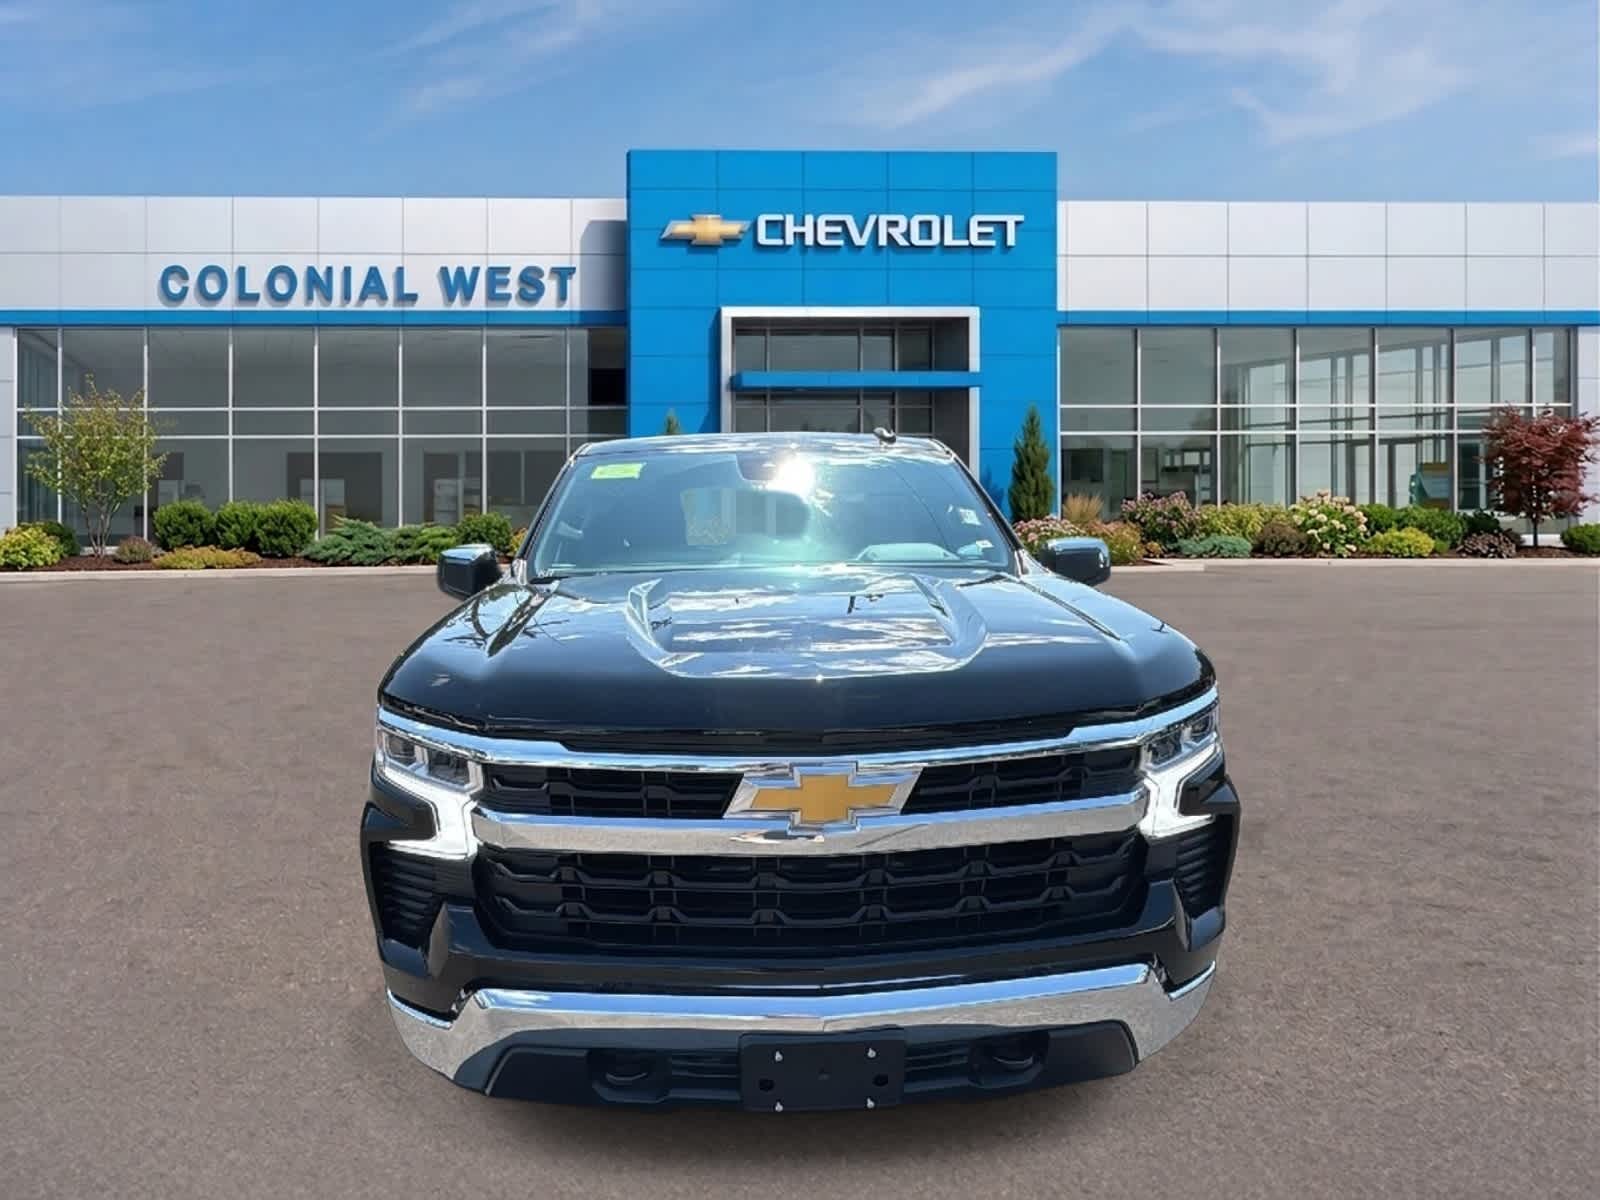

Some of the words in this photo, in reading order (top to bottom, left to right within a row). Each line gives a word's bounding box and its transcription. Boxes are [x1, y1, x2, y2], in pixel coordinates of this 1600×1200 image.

[756, 213, 1025, 247] CHEVROLET
[160, 264, 418, 303] COLONIAL
[439, 265, 577, 304] WEST
